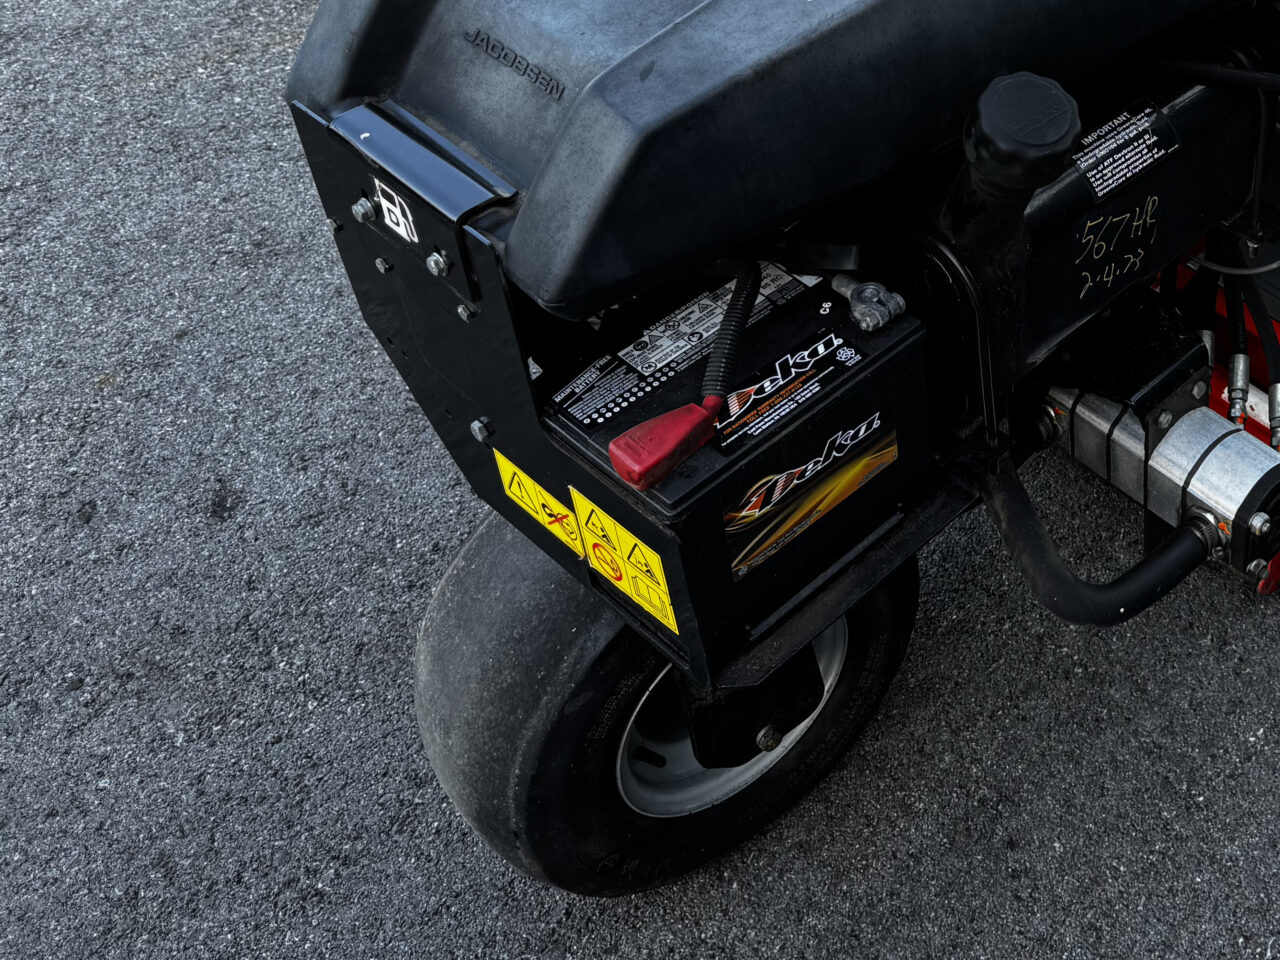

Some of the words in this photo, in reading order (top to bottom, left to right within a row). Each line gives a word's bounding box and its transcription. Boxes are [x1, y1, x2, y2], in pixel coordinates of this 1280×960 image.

[463, 28, 565, 103] JACOBSEN
[1071, 151, 1083, 160] This
[1083, 137, 1105, 153] machine
[1104, 129, 1117, 139] uses
[1080, 111, 1130, 145] IMPORTANT
[1080, 137, 1116, 162] biodegradable
[1101, 156, 1126, 175] approved
[1124, 143, 1146, 159] alternate
[1086, 167, 1098, 178] Use
[1102, 157, 1114, 166] ATF
[1092, 178, 1103, 187] Use
[1102, 171, 1113, 180] will
[1111, 152, 1143, 174] compromise
[1094, 167, 1129, 192] biodegradable
[1127, 151, 1153, 170] properties
[1096, 175, 1127, 197] GreensCare
[1131, 156, 1155, 174] hydraulic
[1075, 214, 1131, 264] 567
[820, 301, 832, 315] C6
[553, 354, 612, 402] MAINTENANCE-FREE
[573, 370, 601, 392] BATTERY
[713, 333, 838, 430] Deka
[805, 368, 816, 376] CALL
[746, 414, 758, 423] TOLL
[758, 405, 770, 415] FREE
[741, 412, 880, 517] Deka
